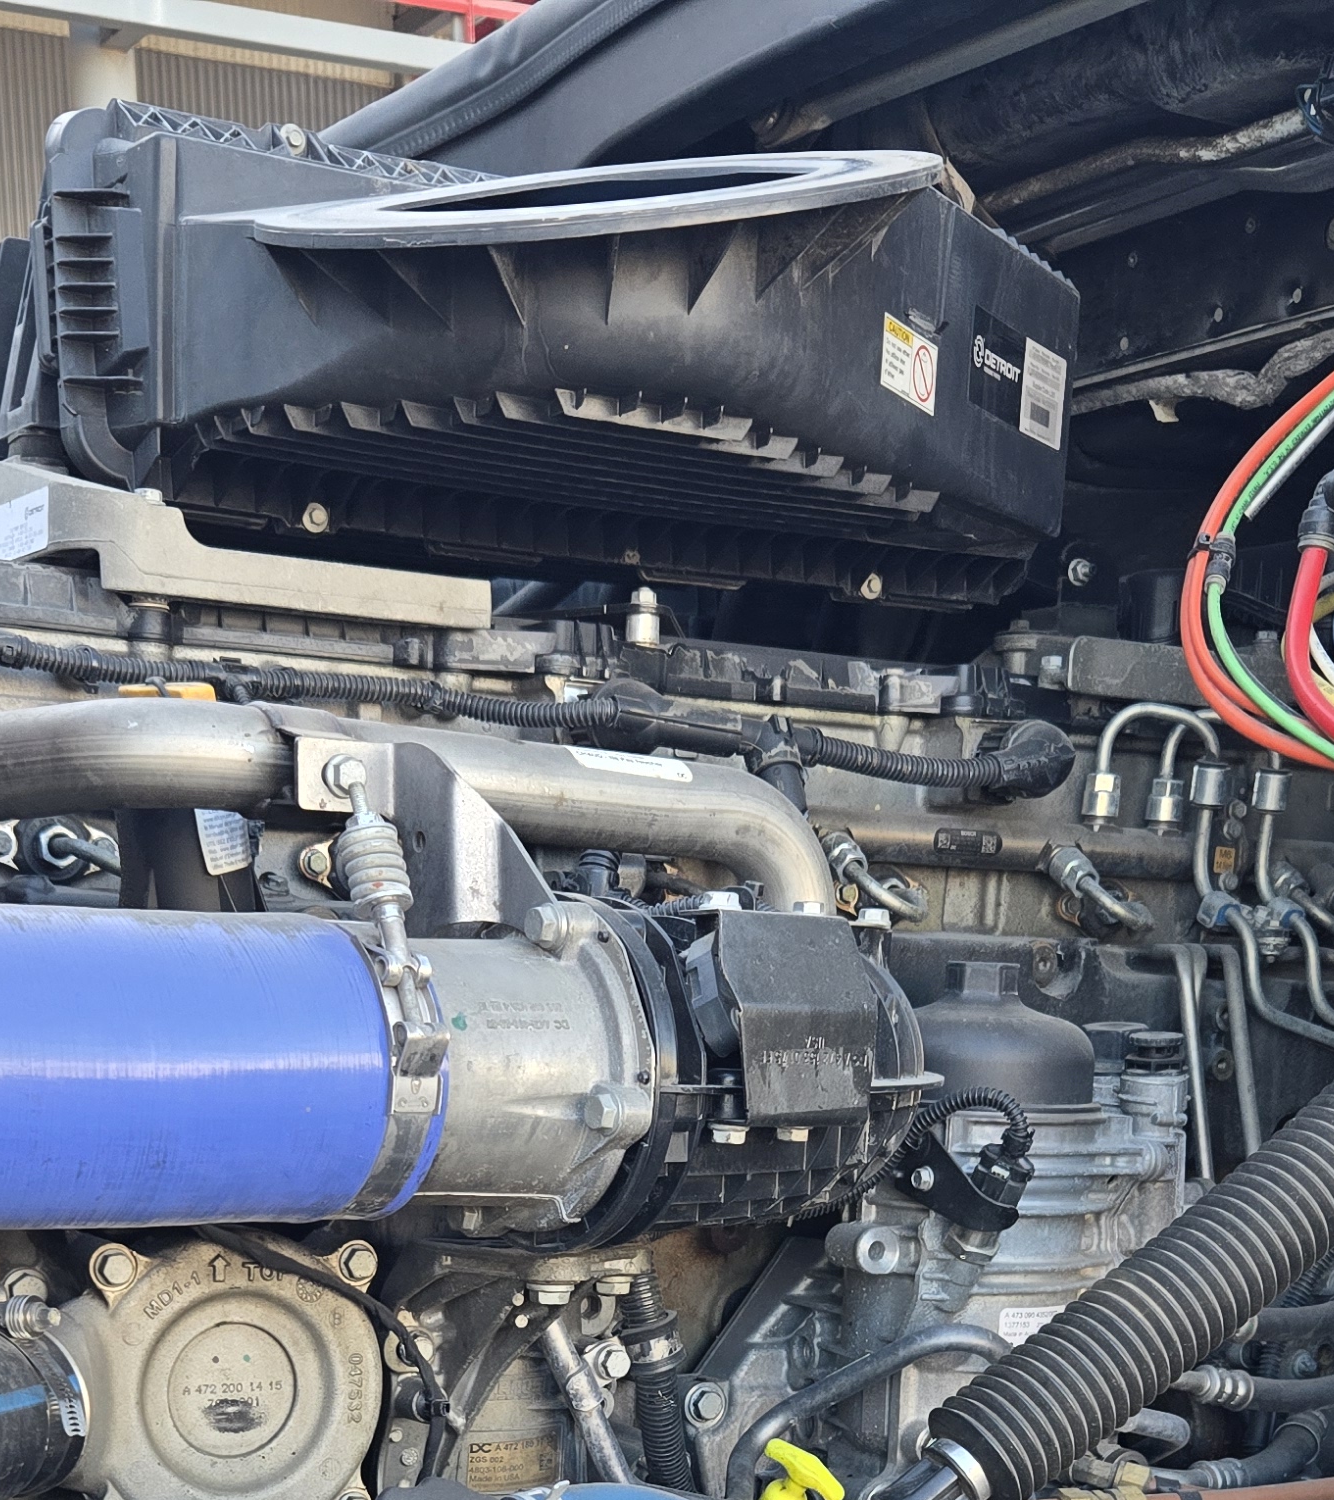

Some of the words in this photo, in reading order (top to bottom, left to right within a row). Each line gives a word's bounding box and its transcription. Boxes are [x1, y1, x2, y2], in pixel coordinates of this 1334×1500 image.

[984, 348, 1021, 383] DETROIT
[143, 1271, 201, 1320] MD1-1
[182, 1385, 192, 1396] A
[195, 1384, 217, 1395] 472
[221, 1382, 243, 1393] 200
[249, 1381, 263, 1392] 14
[268, 1380, 283, 1391] 15
[347, 1353, 364, 1424] 047532
[469, 1443, 492, 1454] DC
[503, 1443, 519, 1451] 472
[469, 1456, 488, 1464] ZGS
[504, 1473, 520, 1481] USA
